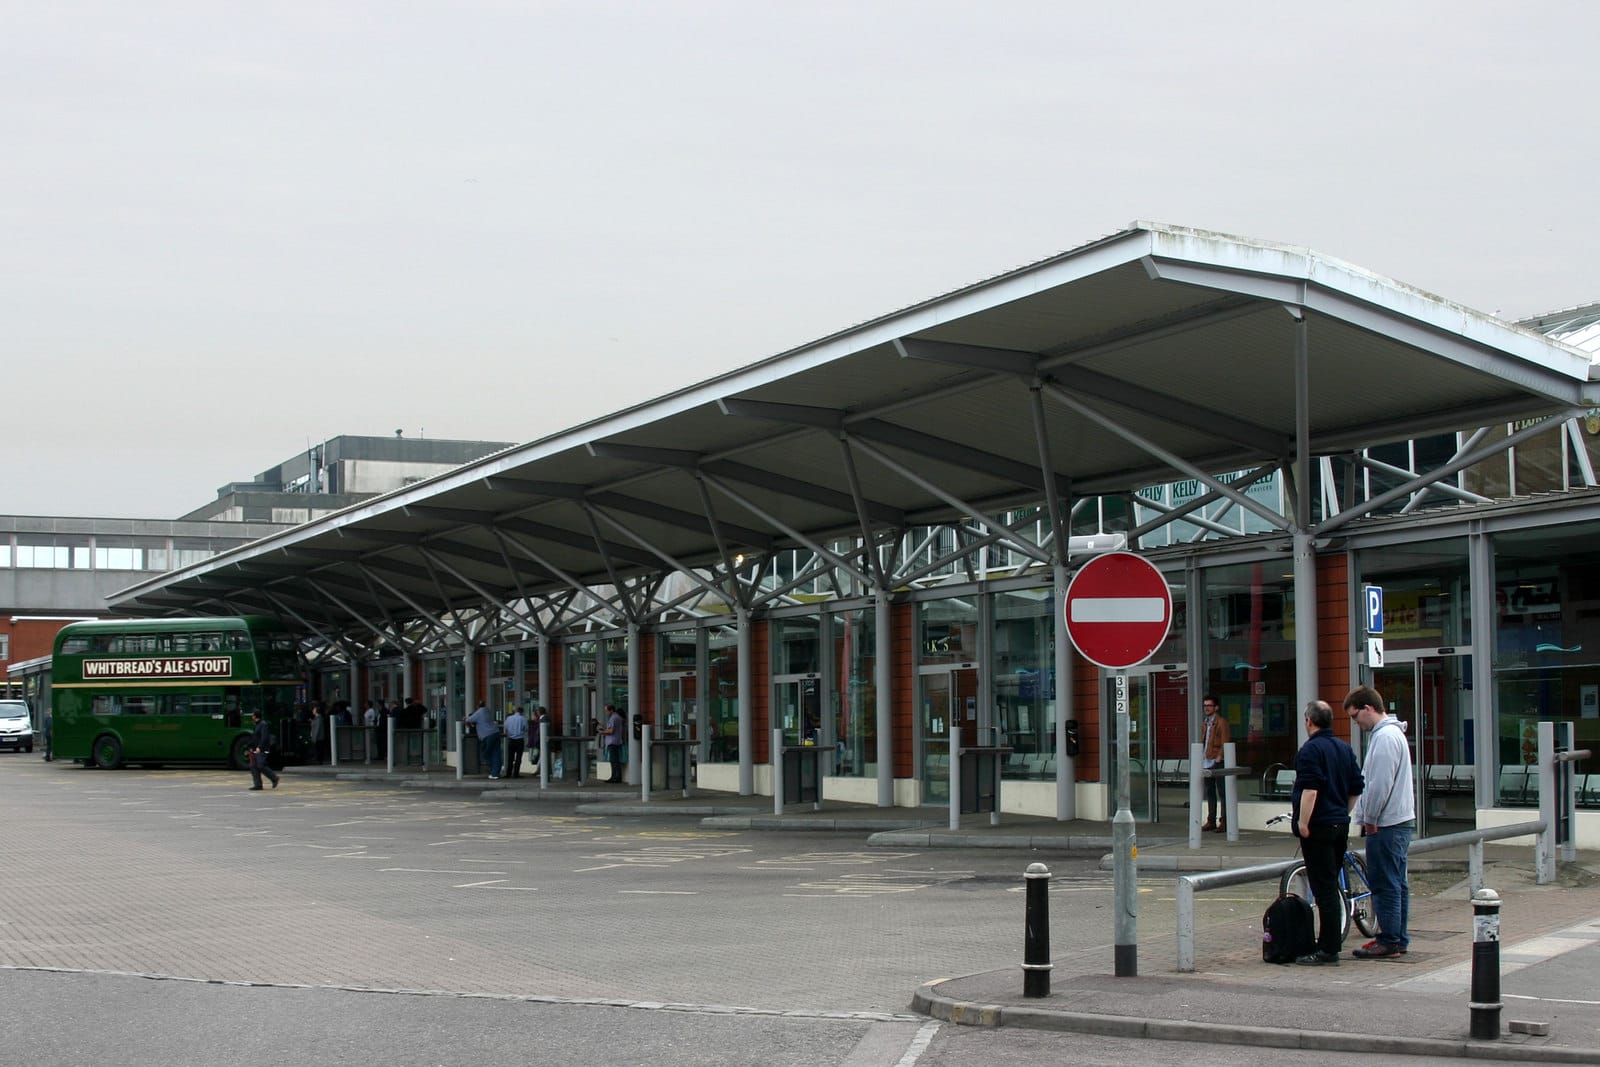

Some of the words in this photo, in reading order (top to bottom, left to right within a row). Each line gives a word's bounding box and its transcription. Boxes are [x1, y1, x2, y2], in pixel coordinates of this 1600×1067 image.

[1173, 480, 1198, 498] KELLY
[1369, 591, 1379, 629] P
[86, 660, 161, 674] WHITBREAD'S
[163, 661, 184, 673] ALE
[191, 660, 229, 672] STOUT
